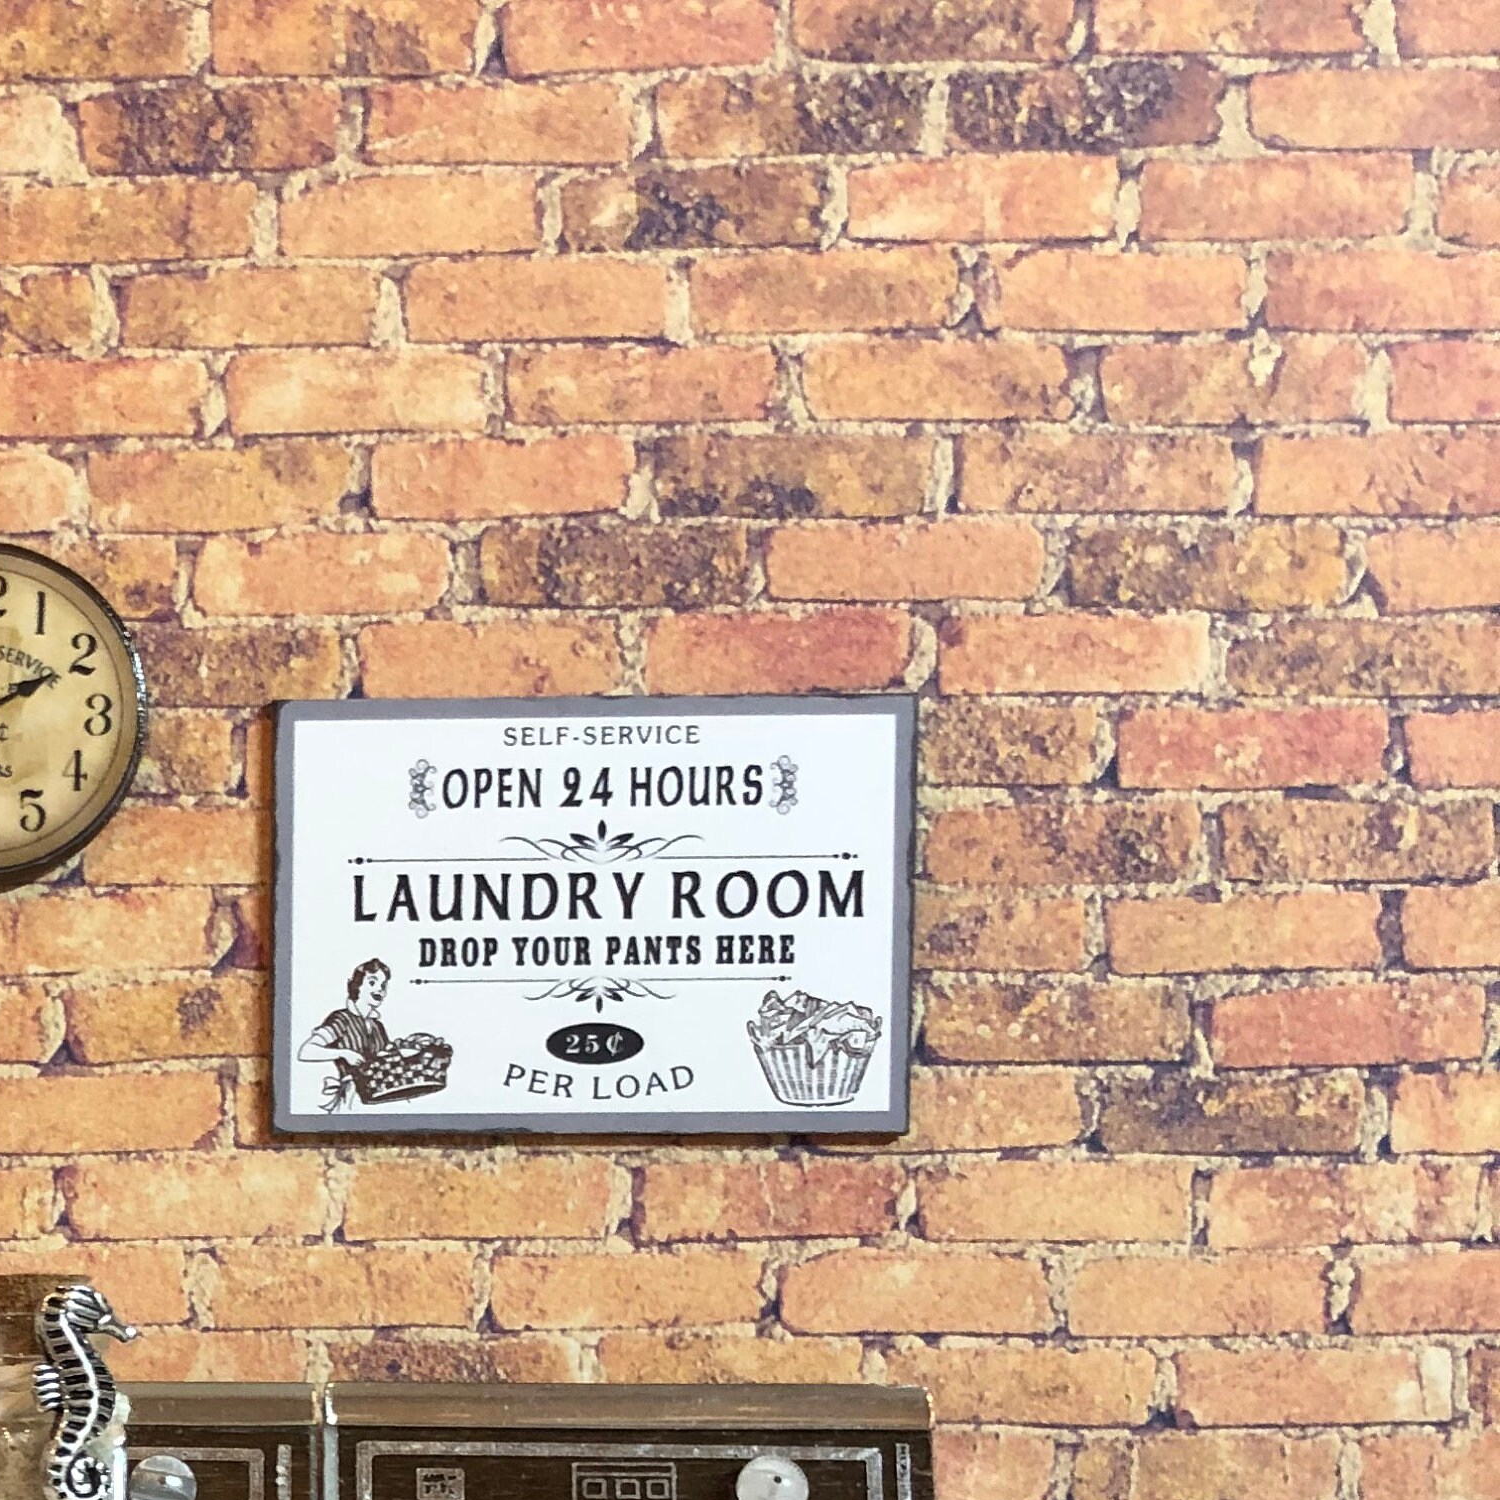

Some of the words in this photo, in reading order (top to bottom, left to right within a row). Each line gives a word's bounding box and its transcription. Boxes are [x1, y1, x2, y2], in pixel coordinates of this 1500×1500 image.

[35, 590, 46, 636] 1
[68, 632, 98, 676] 2
[83, 693, 113, 736] 3
[503, 724, 702, 747] SELF-SERVICE
[62, 750, 88, 792] 4
[442, 767, 543, 809] OPEN
[559, 766, 614, 808] 24
[630, 764, 763, 807] HOURS
[19, 788, 47, 832] 5
[353, 871, 645, 922] LAUNDRY
[671, 869, 865, 919] ROOM
[418, 936, 499, 968] DROP
[511, 935, 593, 967] YOUR
[605, 934, 702, 966] PANTS
[715, 934, 795, 965] HERE
[565, 1031, 624, 1056] 25¢
[503, 1063, 574, 1098] PER
[592, 1065, 694, 1099] LOAD
